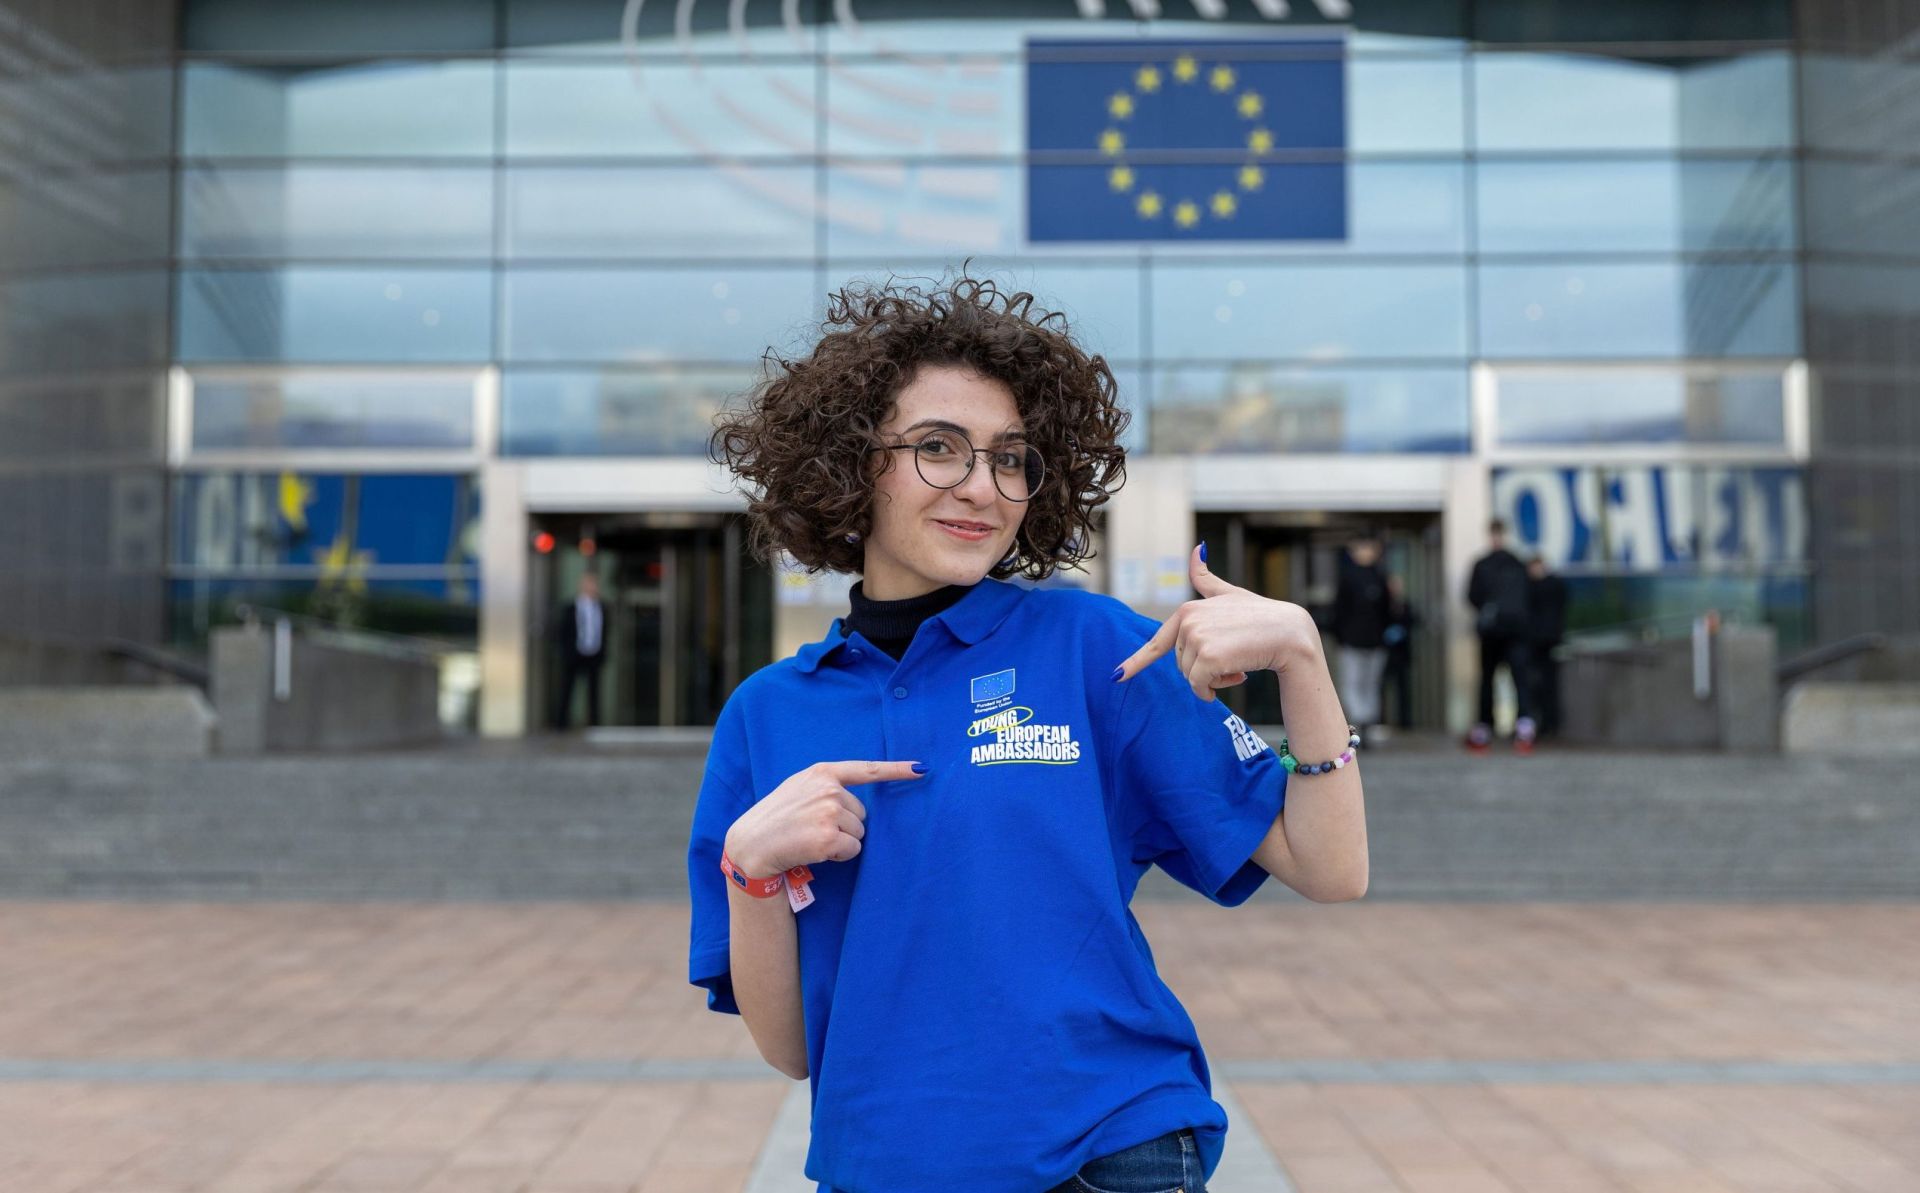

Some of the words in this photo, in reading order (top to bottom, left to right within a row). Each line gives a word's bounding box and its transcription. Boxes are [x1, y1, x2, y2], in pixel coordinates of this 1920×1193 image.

[972, 710, 1018, 735] YOUNG
[998, 725, 1070, 743] EUROPEAN
[1223, 714, 1246, 741] EU
[971, 741, 1080, 763] AMBASSADORS
